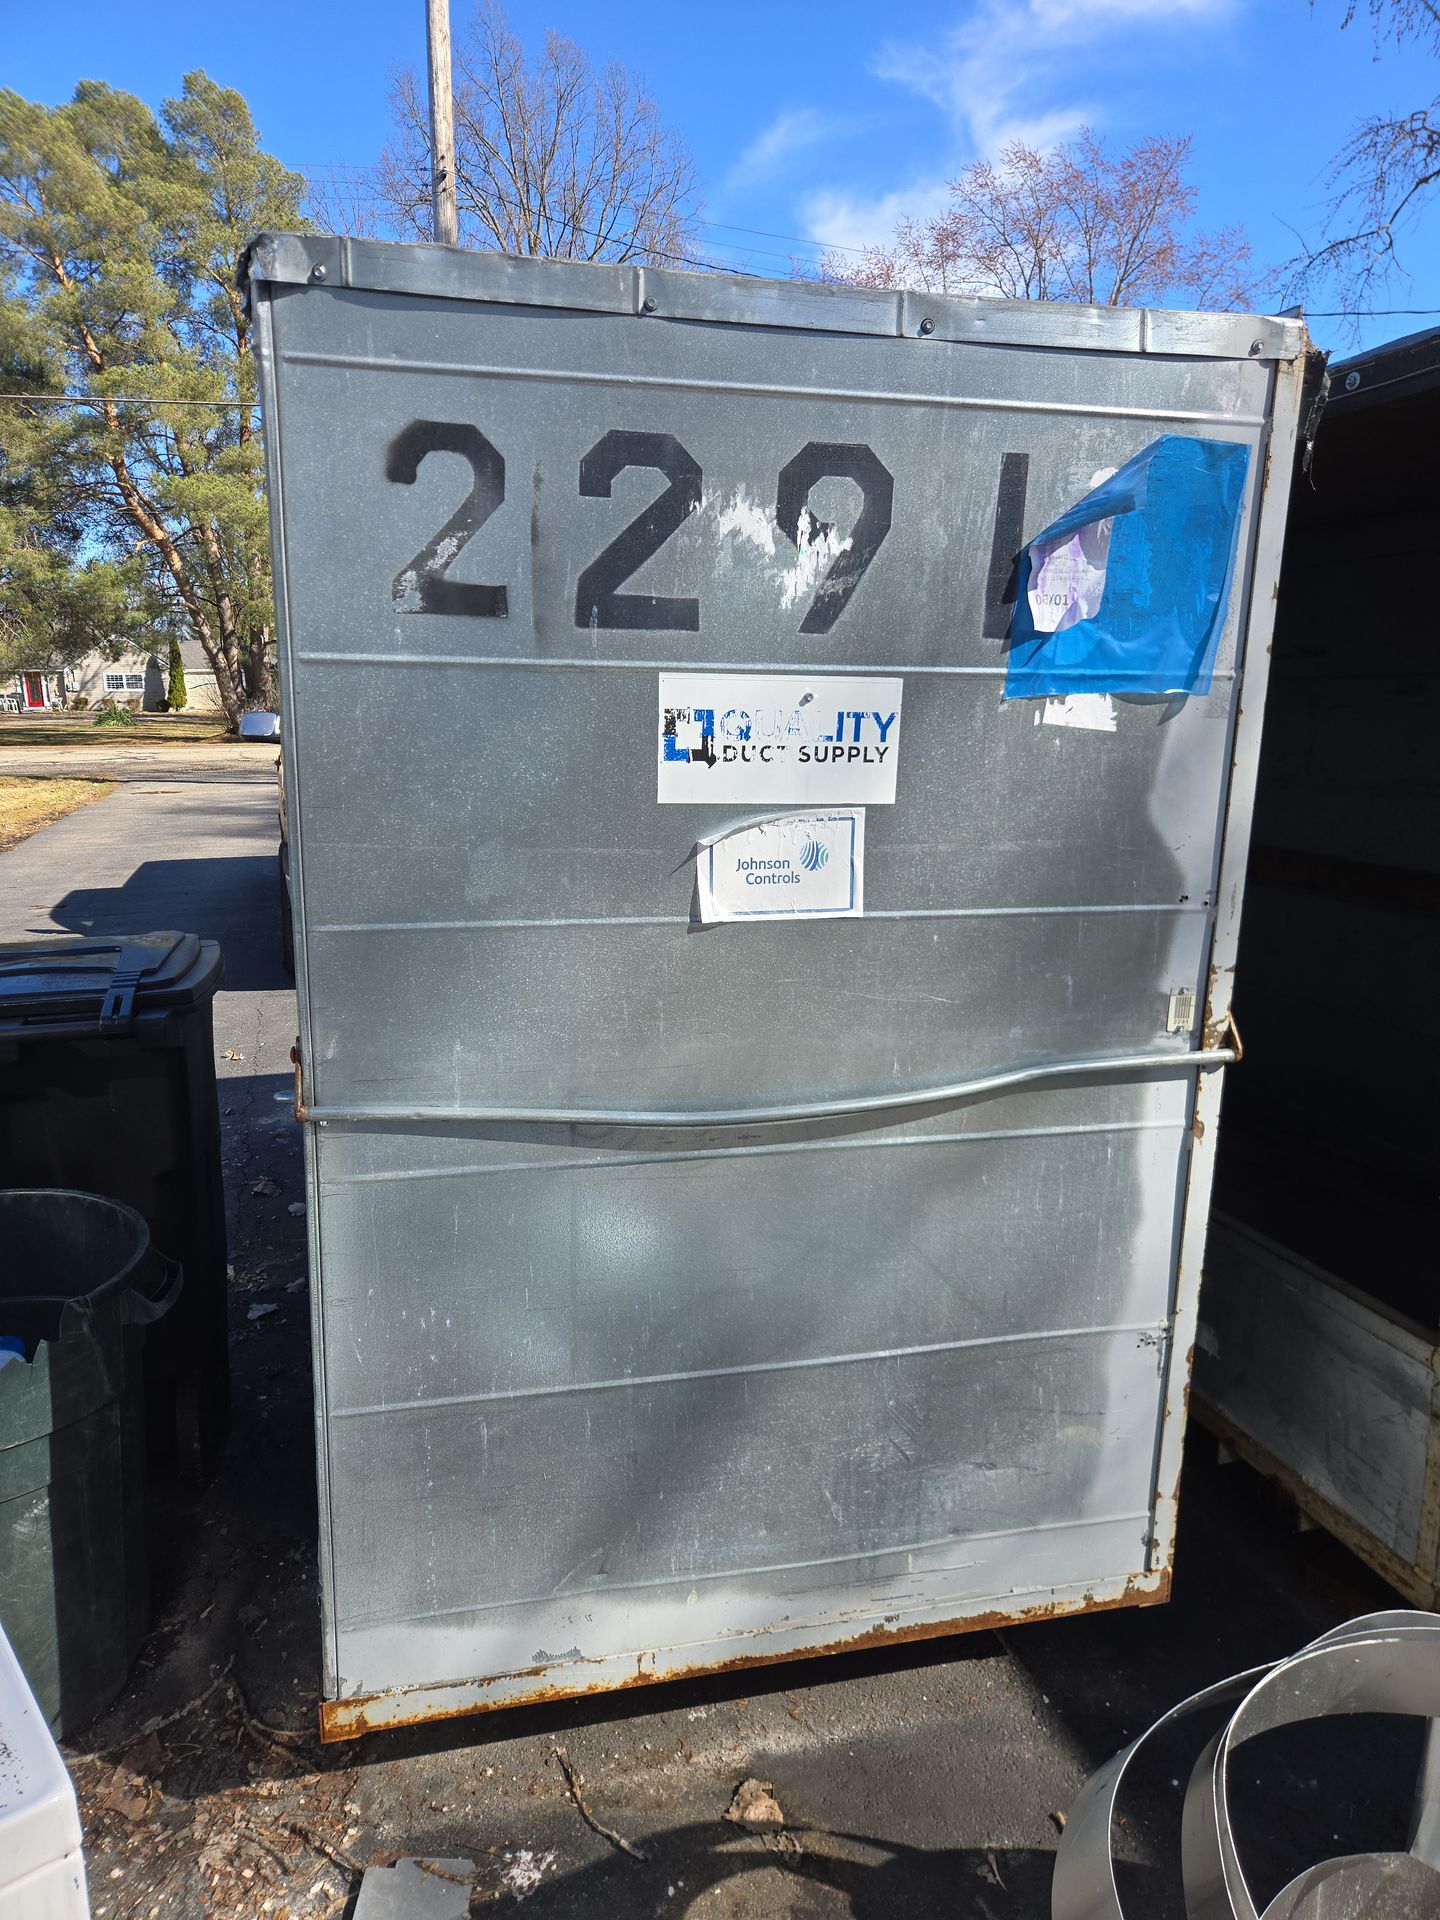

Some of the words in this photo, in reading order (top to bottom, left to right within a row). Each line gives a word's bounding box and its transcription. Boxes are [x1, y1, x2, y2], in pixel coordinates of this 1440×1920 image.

[386, 419, 1029, 639] 2291
[798, 745, 889, 763] SUPPLY
[736, 857, 790, 872] Johnson
[745, 872, 801, 885] Controls
